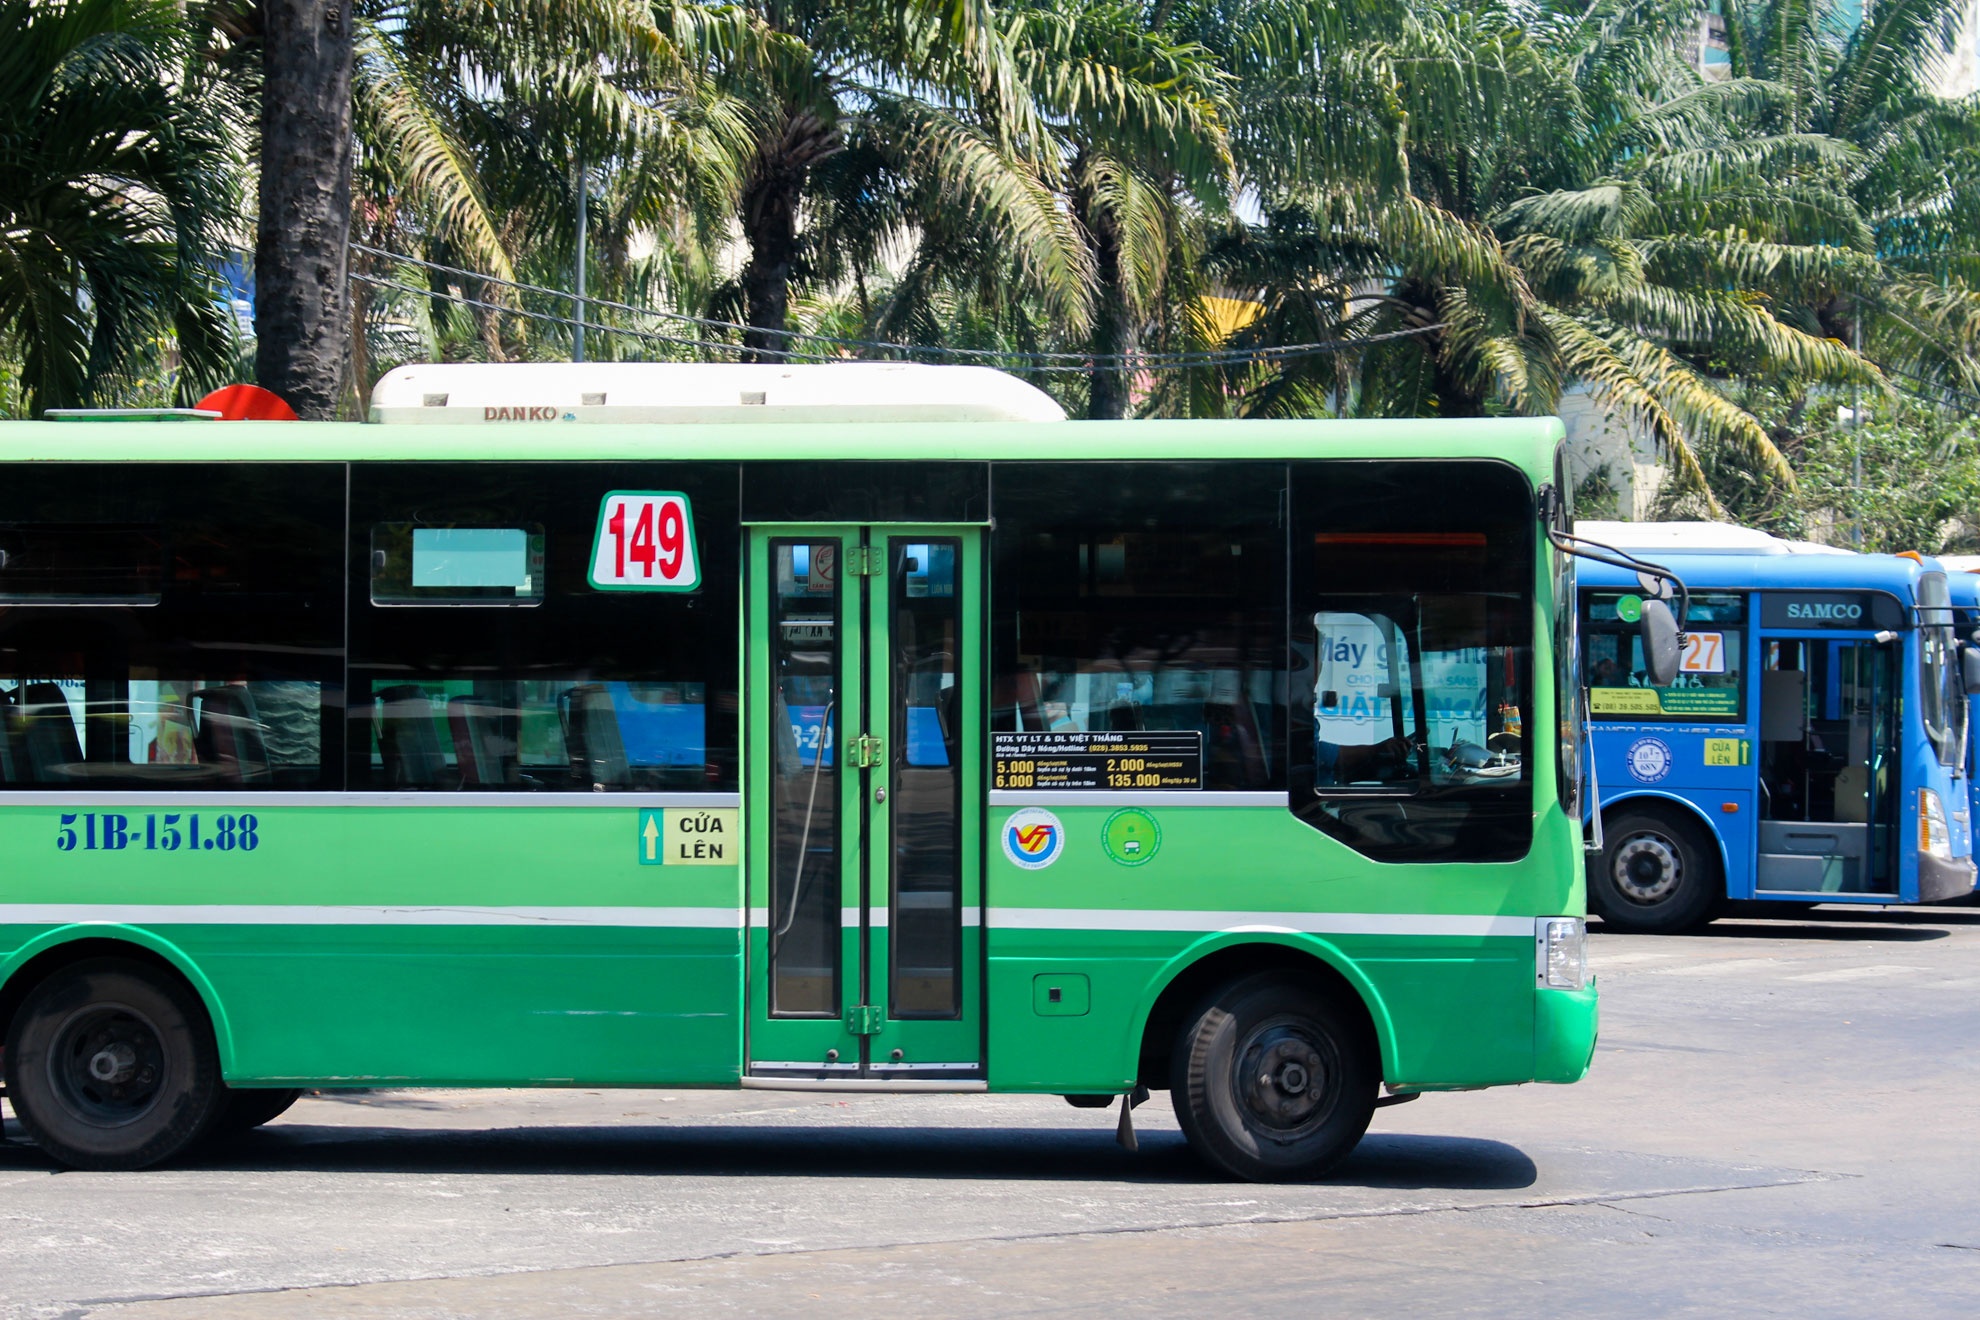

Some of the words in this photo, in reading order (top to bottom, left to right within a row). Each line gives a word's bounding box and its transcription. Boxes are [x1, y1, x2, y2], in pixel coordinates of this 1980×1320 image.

[484, 407, 558, 421] DANKO
[609, 501, 684, 580] 149
[1787, 603, 1862, 619] SAMCO
[995, 735, 1014, 743] HTX
[1016, 735, 1028, 743] VT
[1030, 735, 1041, 743] LT
[1044, 735, 1052, 743] &
[1069, 734, 1090, 743] VIỆT
[1092, 733, 1124, 742] THẮNG
[1107, 758, 1145, 772] 2.000
[1711, 753, 1730, 765] LÊN
[996, 760, 1035, 774] 5.000
[996, 774, 1034, 788] 6.000
[1107, 773, 1161, 787] 135.000
[679, 811, 724, 833] CỬA
[57, 813, 260, 851] 51B-151.88
[680, 839, 723, 859] LÊN
